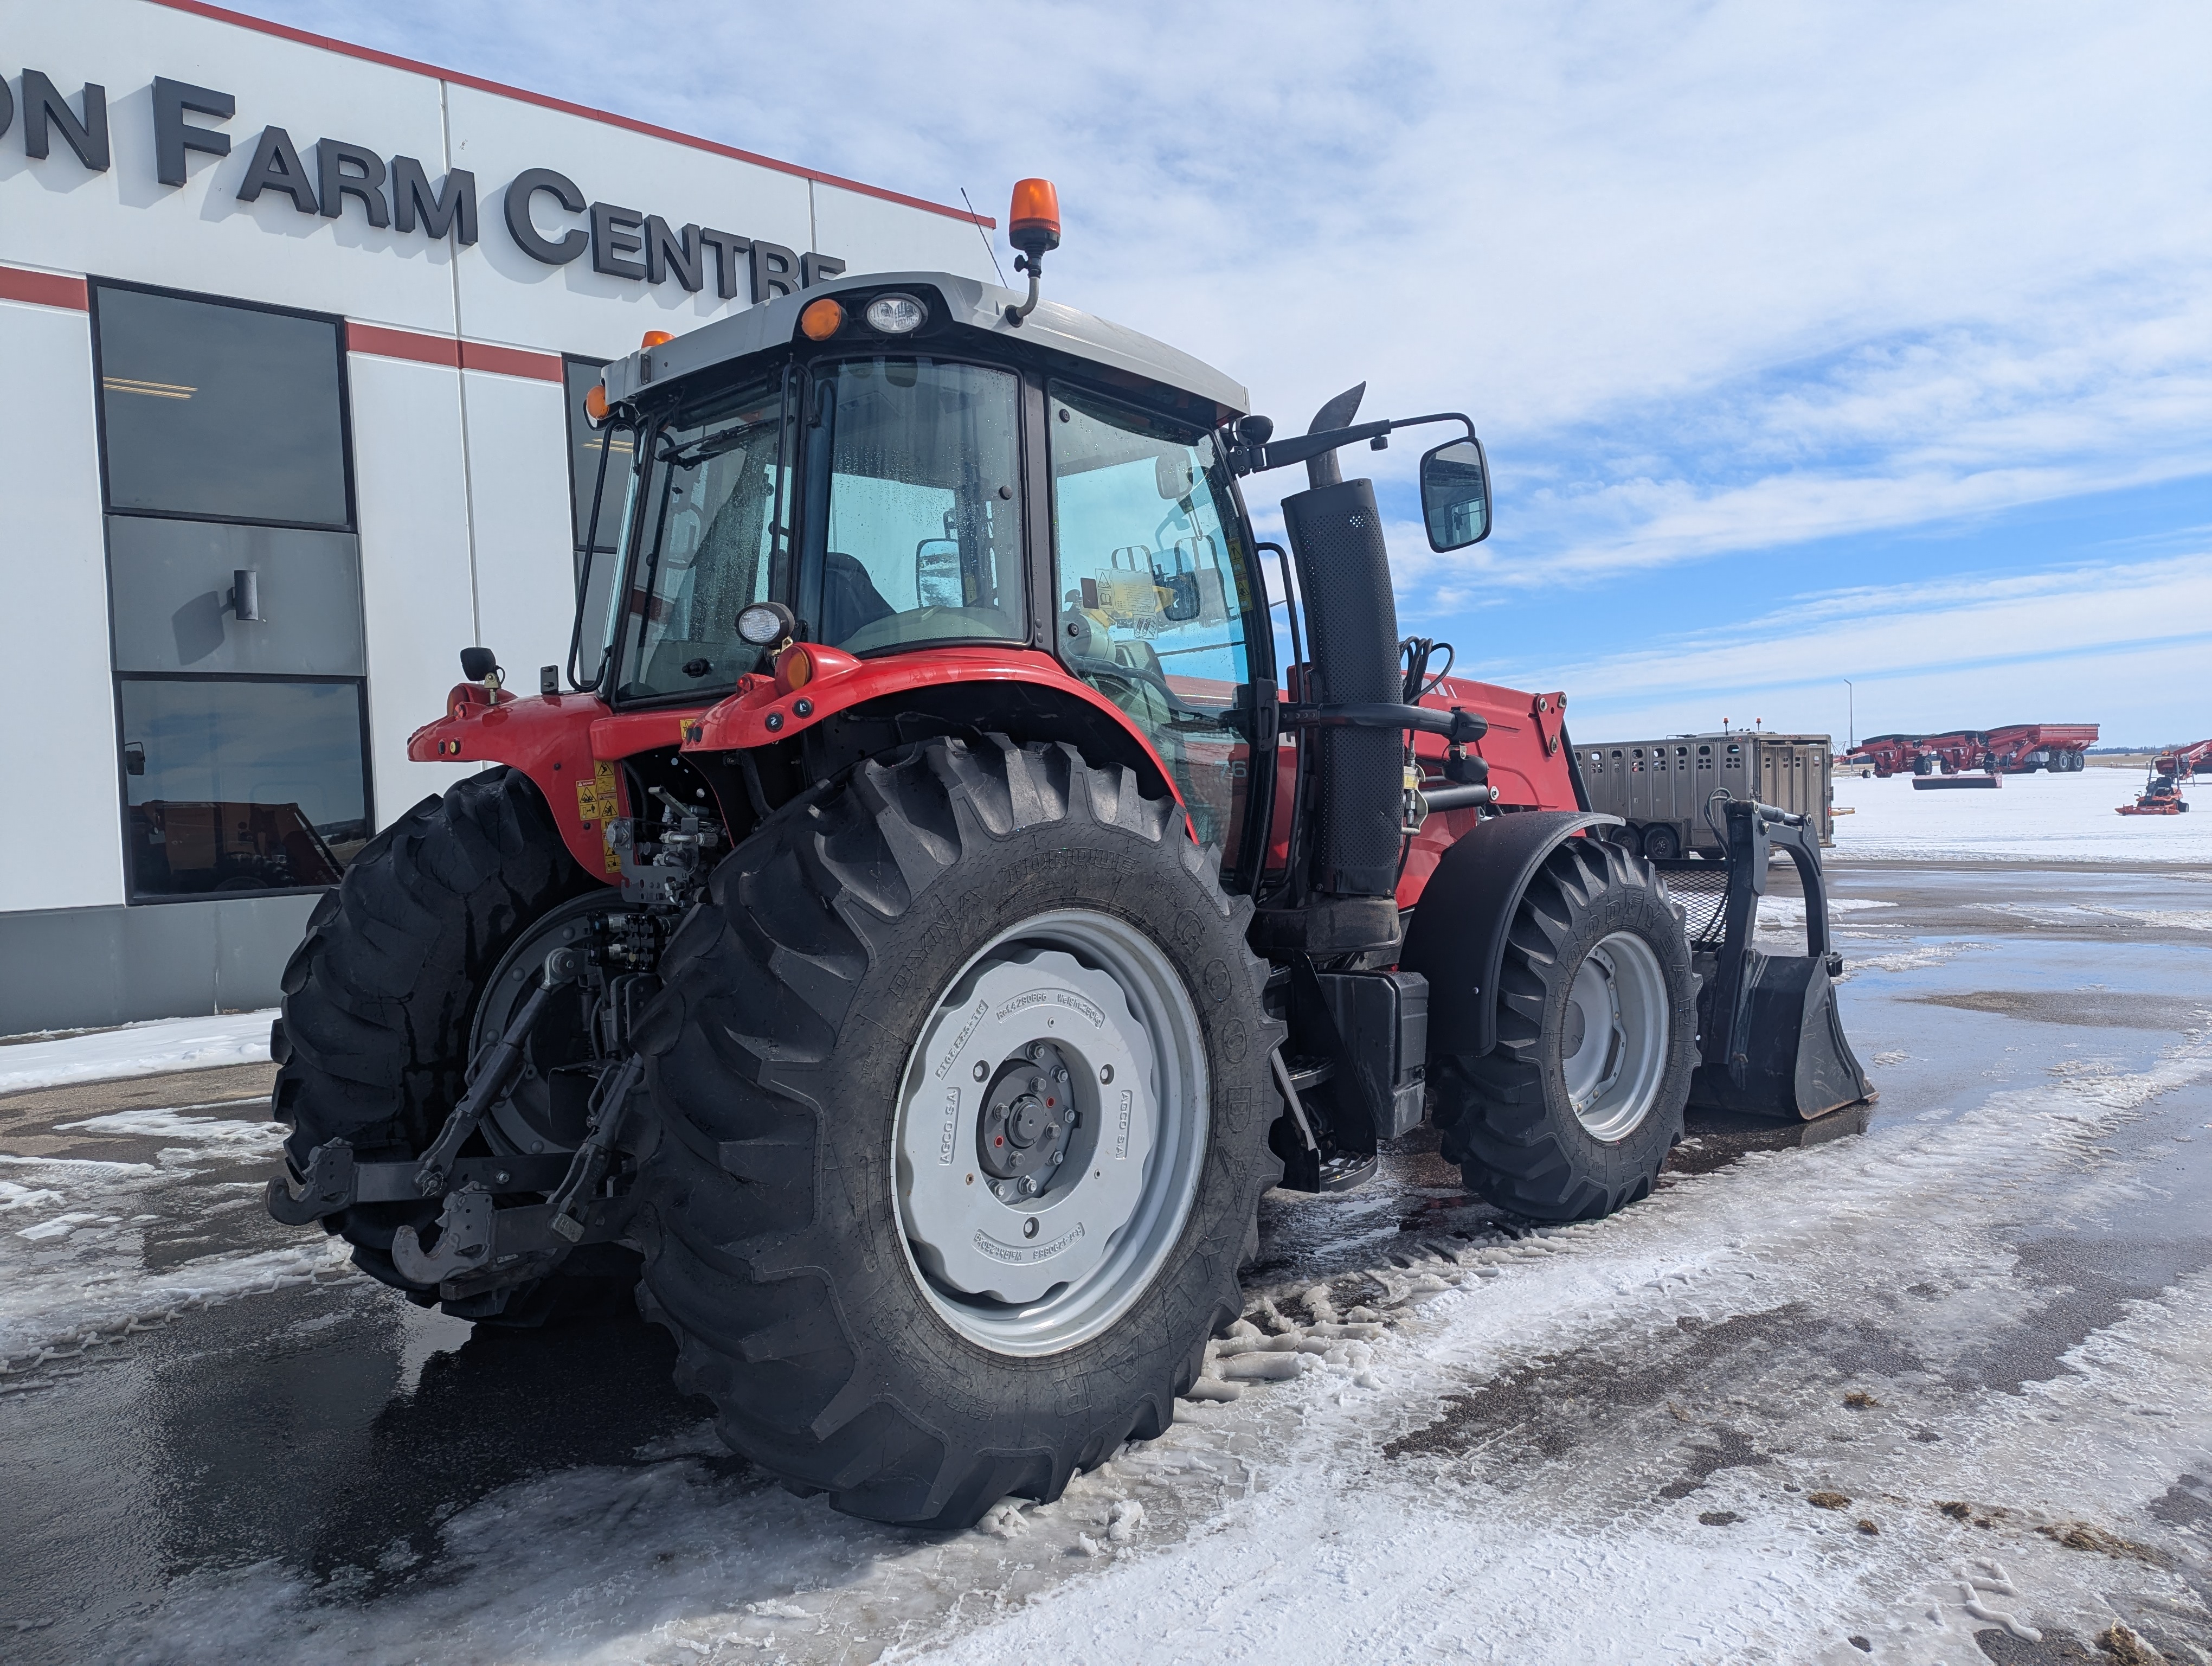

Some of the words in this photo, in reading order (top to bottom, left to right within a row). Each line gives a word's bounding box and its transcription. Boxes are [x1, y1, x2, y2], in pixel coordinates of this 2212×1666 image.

[0, 68, 110, 172] N
[152, 75, 478, 246] FARM
[888, 889, 988, 1000] DYNA
[1001, 847, 1139, 883] TORQUE
[940, 1120, 954, 1164] AGCO
[1119, 1091, 1130, 1130] AGCO
